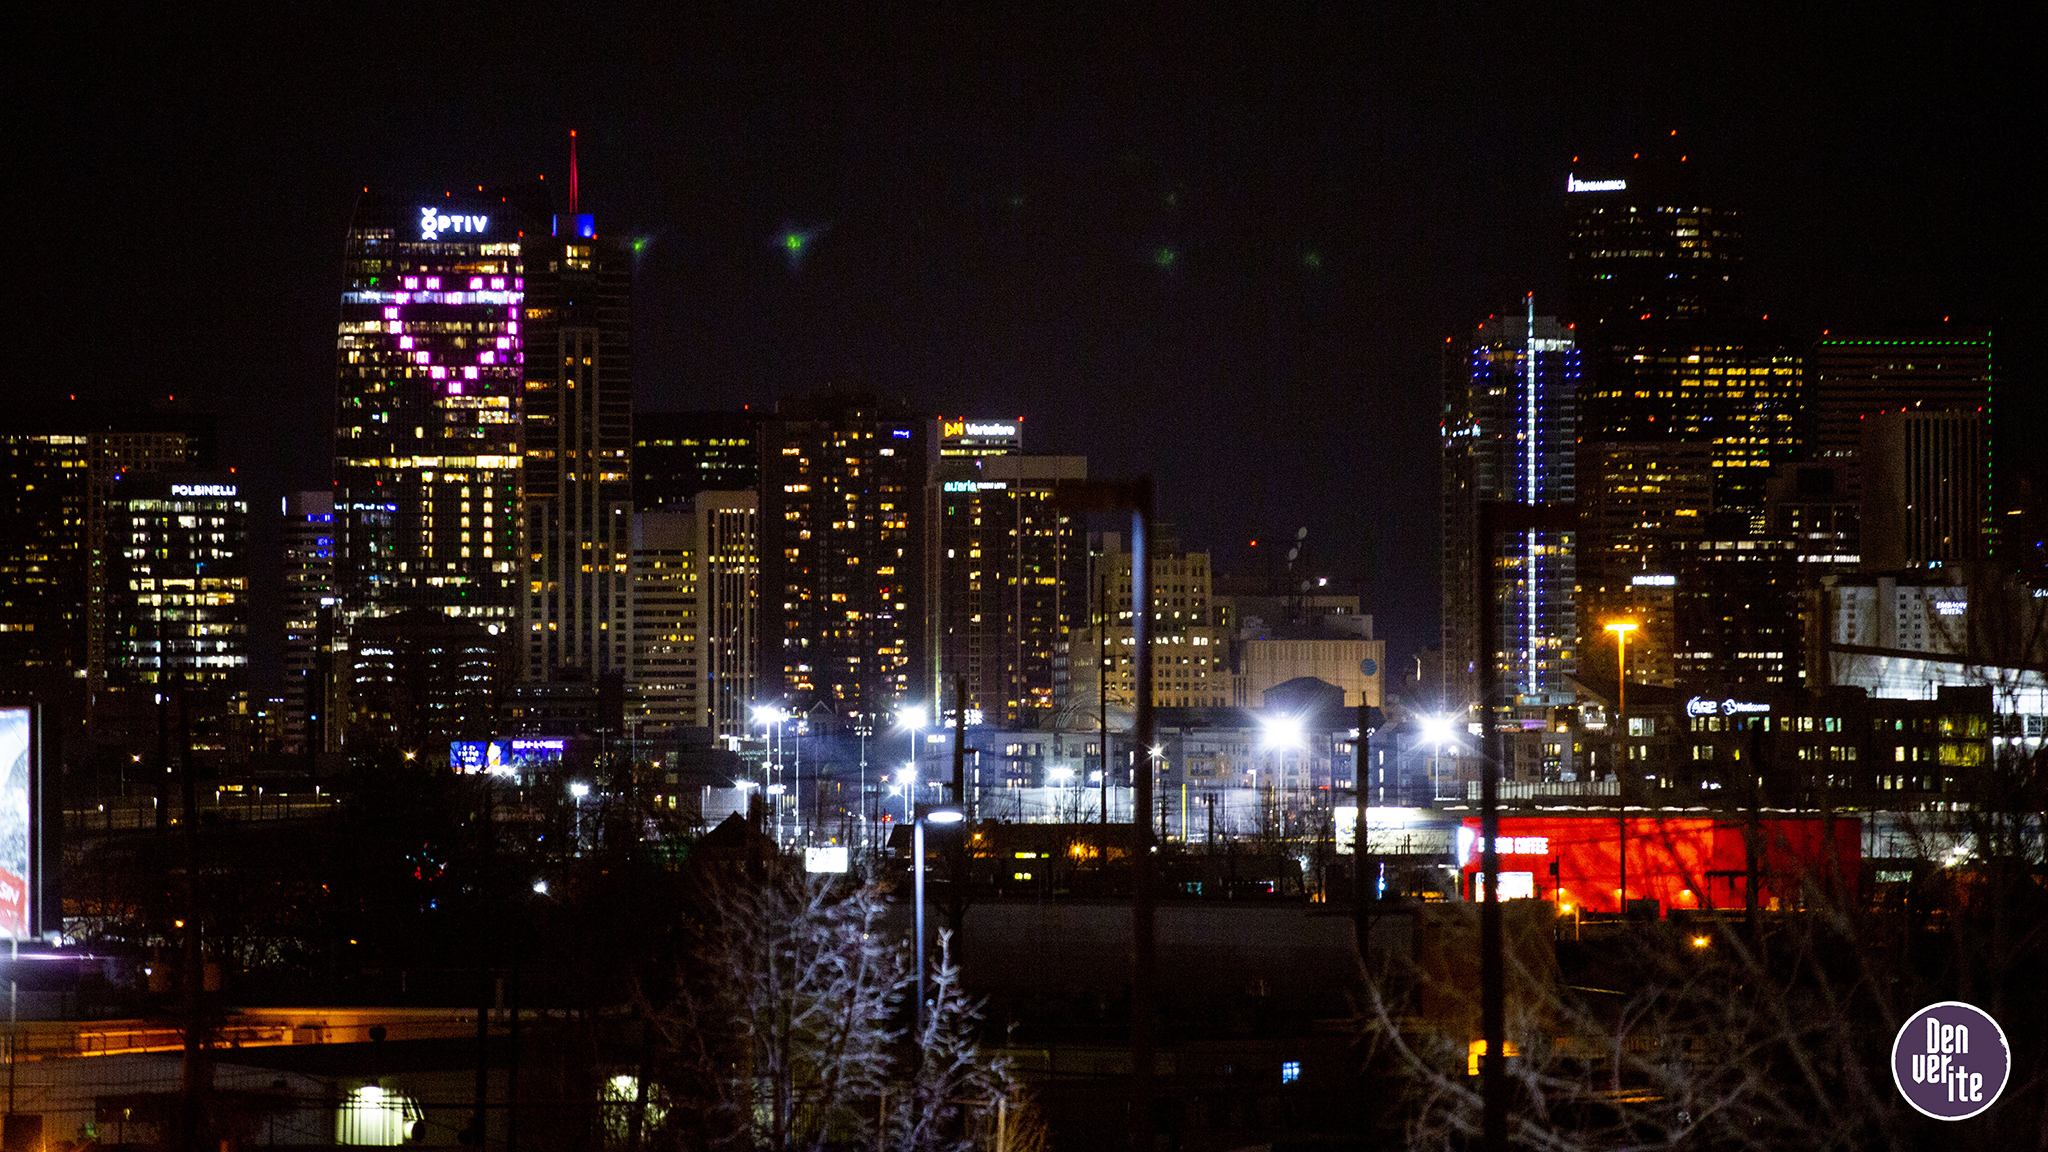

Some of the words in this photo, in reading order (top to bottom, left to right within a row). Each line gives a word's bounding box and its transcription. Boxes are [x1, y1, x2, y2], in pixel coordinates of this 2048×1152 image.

[421, 207, 488, 240] OPTIV
[171, 485, 237, 496] POLSINELLI
[1514, 837, 1549, 854] COFFEE
